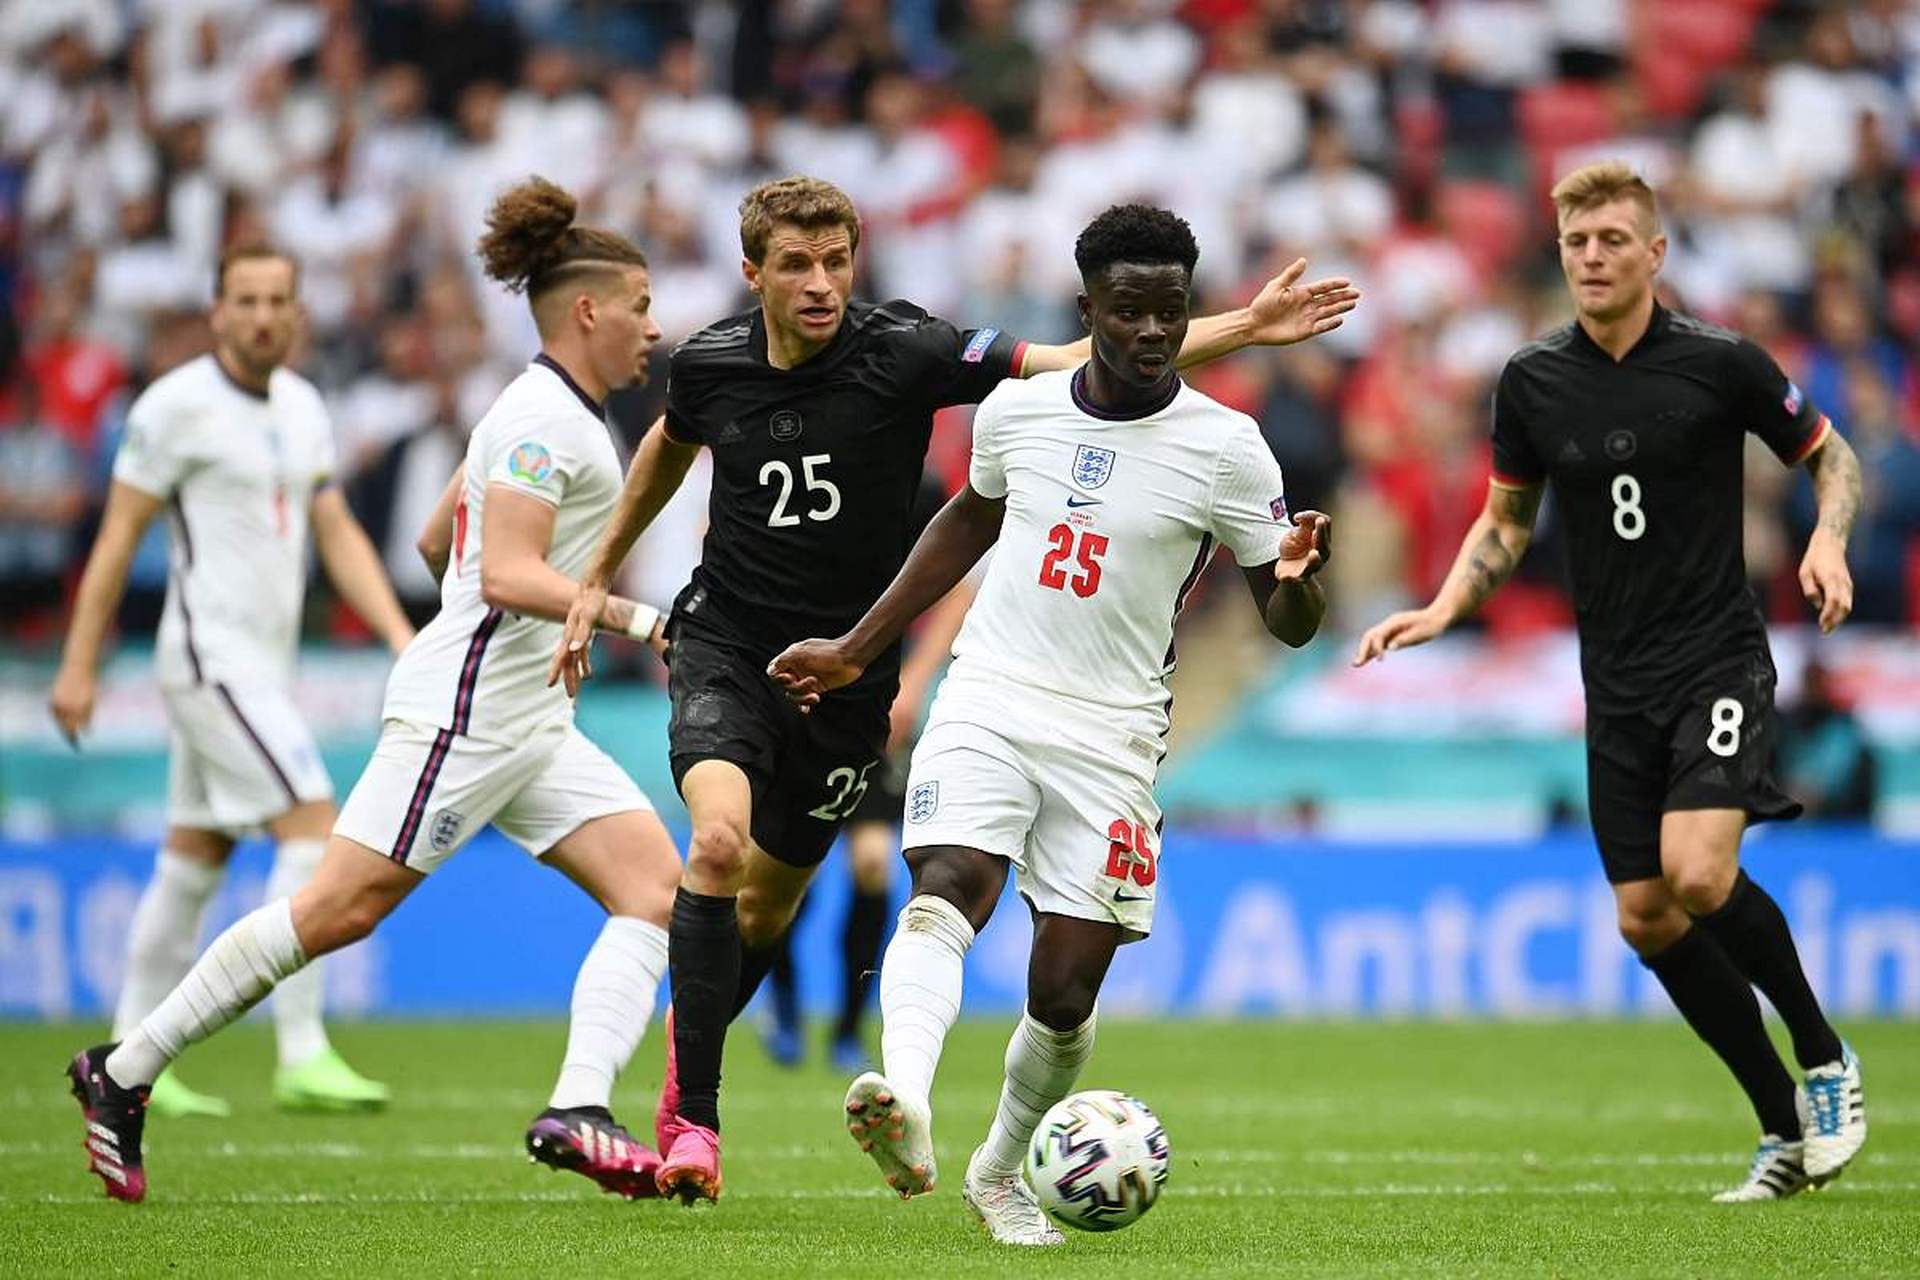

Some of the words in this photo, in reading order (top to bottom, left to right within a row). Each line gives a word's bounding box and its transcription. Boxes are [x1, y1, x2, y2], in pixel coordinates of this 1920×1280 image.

[759, 453, 841, 527] 25
[1611, 473, 1646, 540] 8
[1038, 523, 1110, 599] 25
[1706, 697, 1744, 757] 8
[808, 760, 879, 820] 25
[1104, 818, 1156, 887] 25
[1202, 878, 1920, 1019] AntChin
